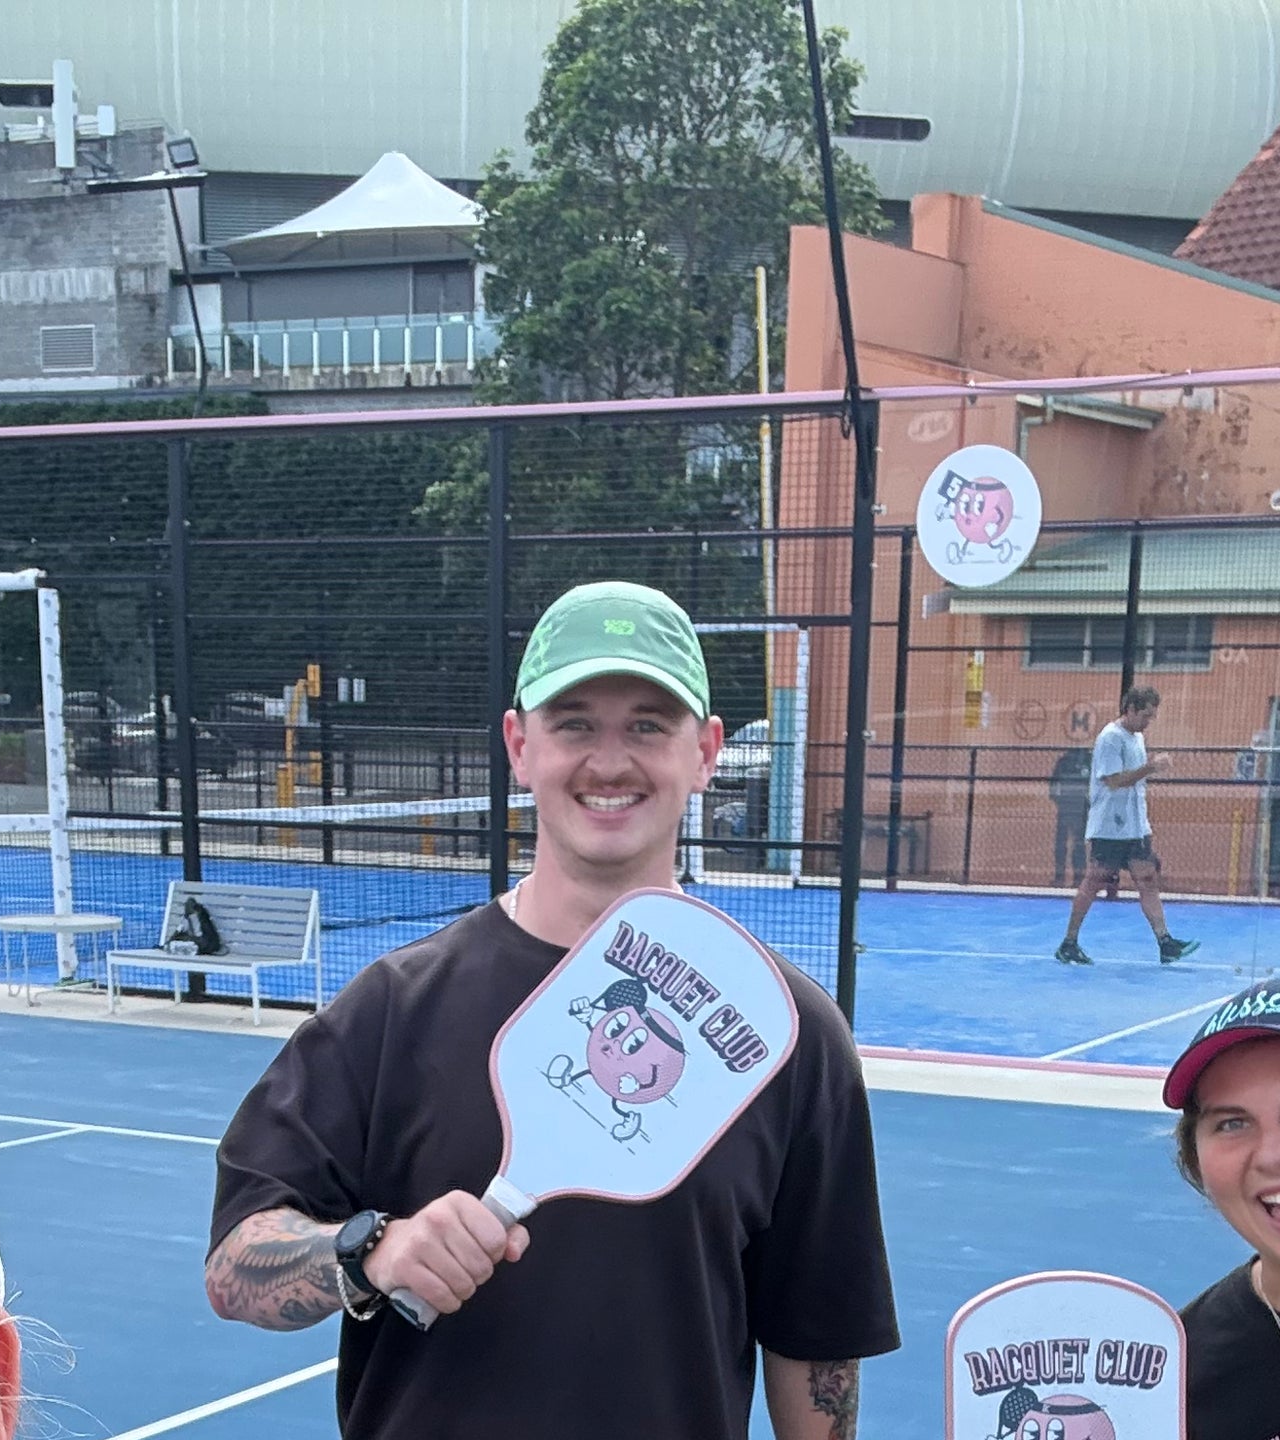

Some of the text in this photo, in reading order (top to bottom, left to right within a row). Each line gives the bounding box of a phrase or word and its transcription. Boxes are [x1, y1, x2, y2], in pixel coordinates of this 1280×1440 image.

[947, 476, 963, 499] 5
[603, 920, 769, 1073] RACQUET CLUB
[964, 1338, 1168, 1396] RACQUET CLUB
